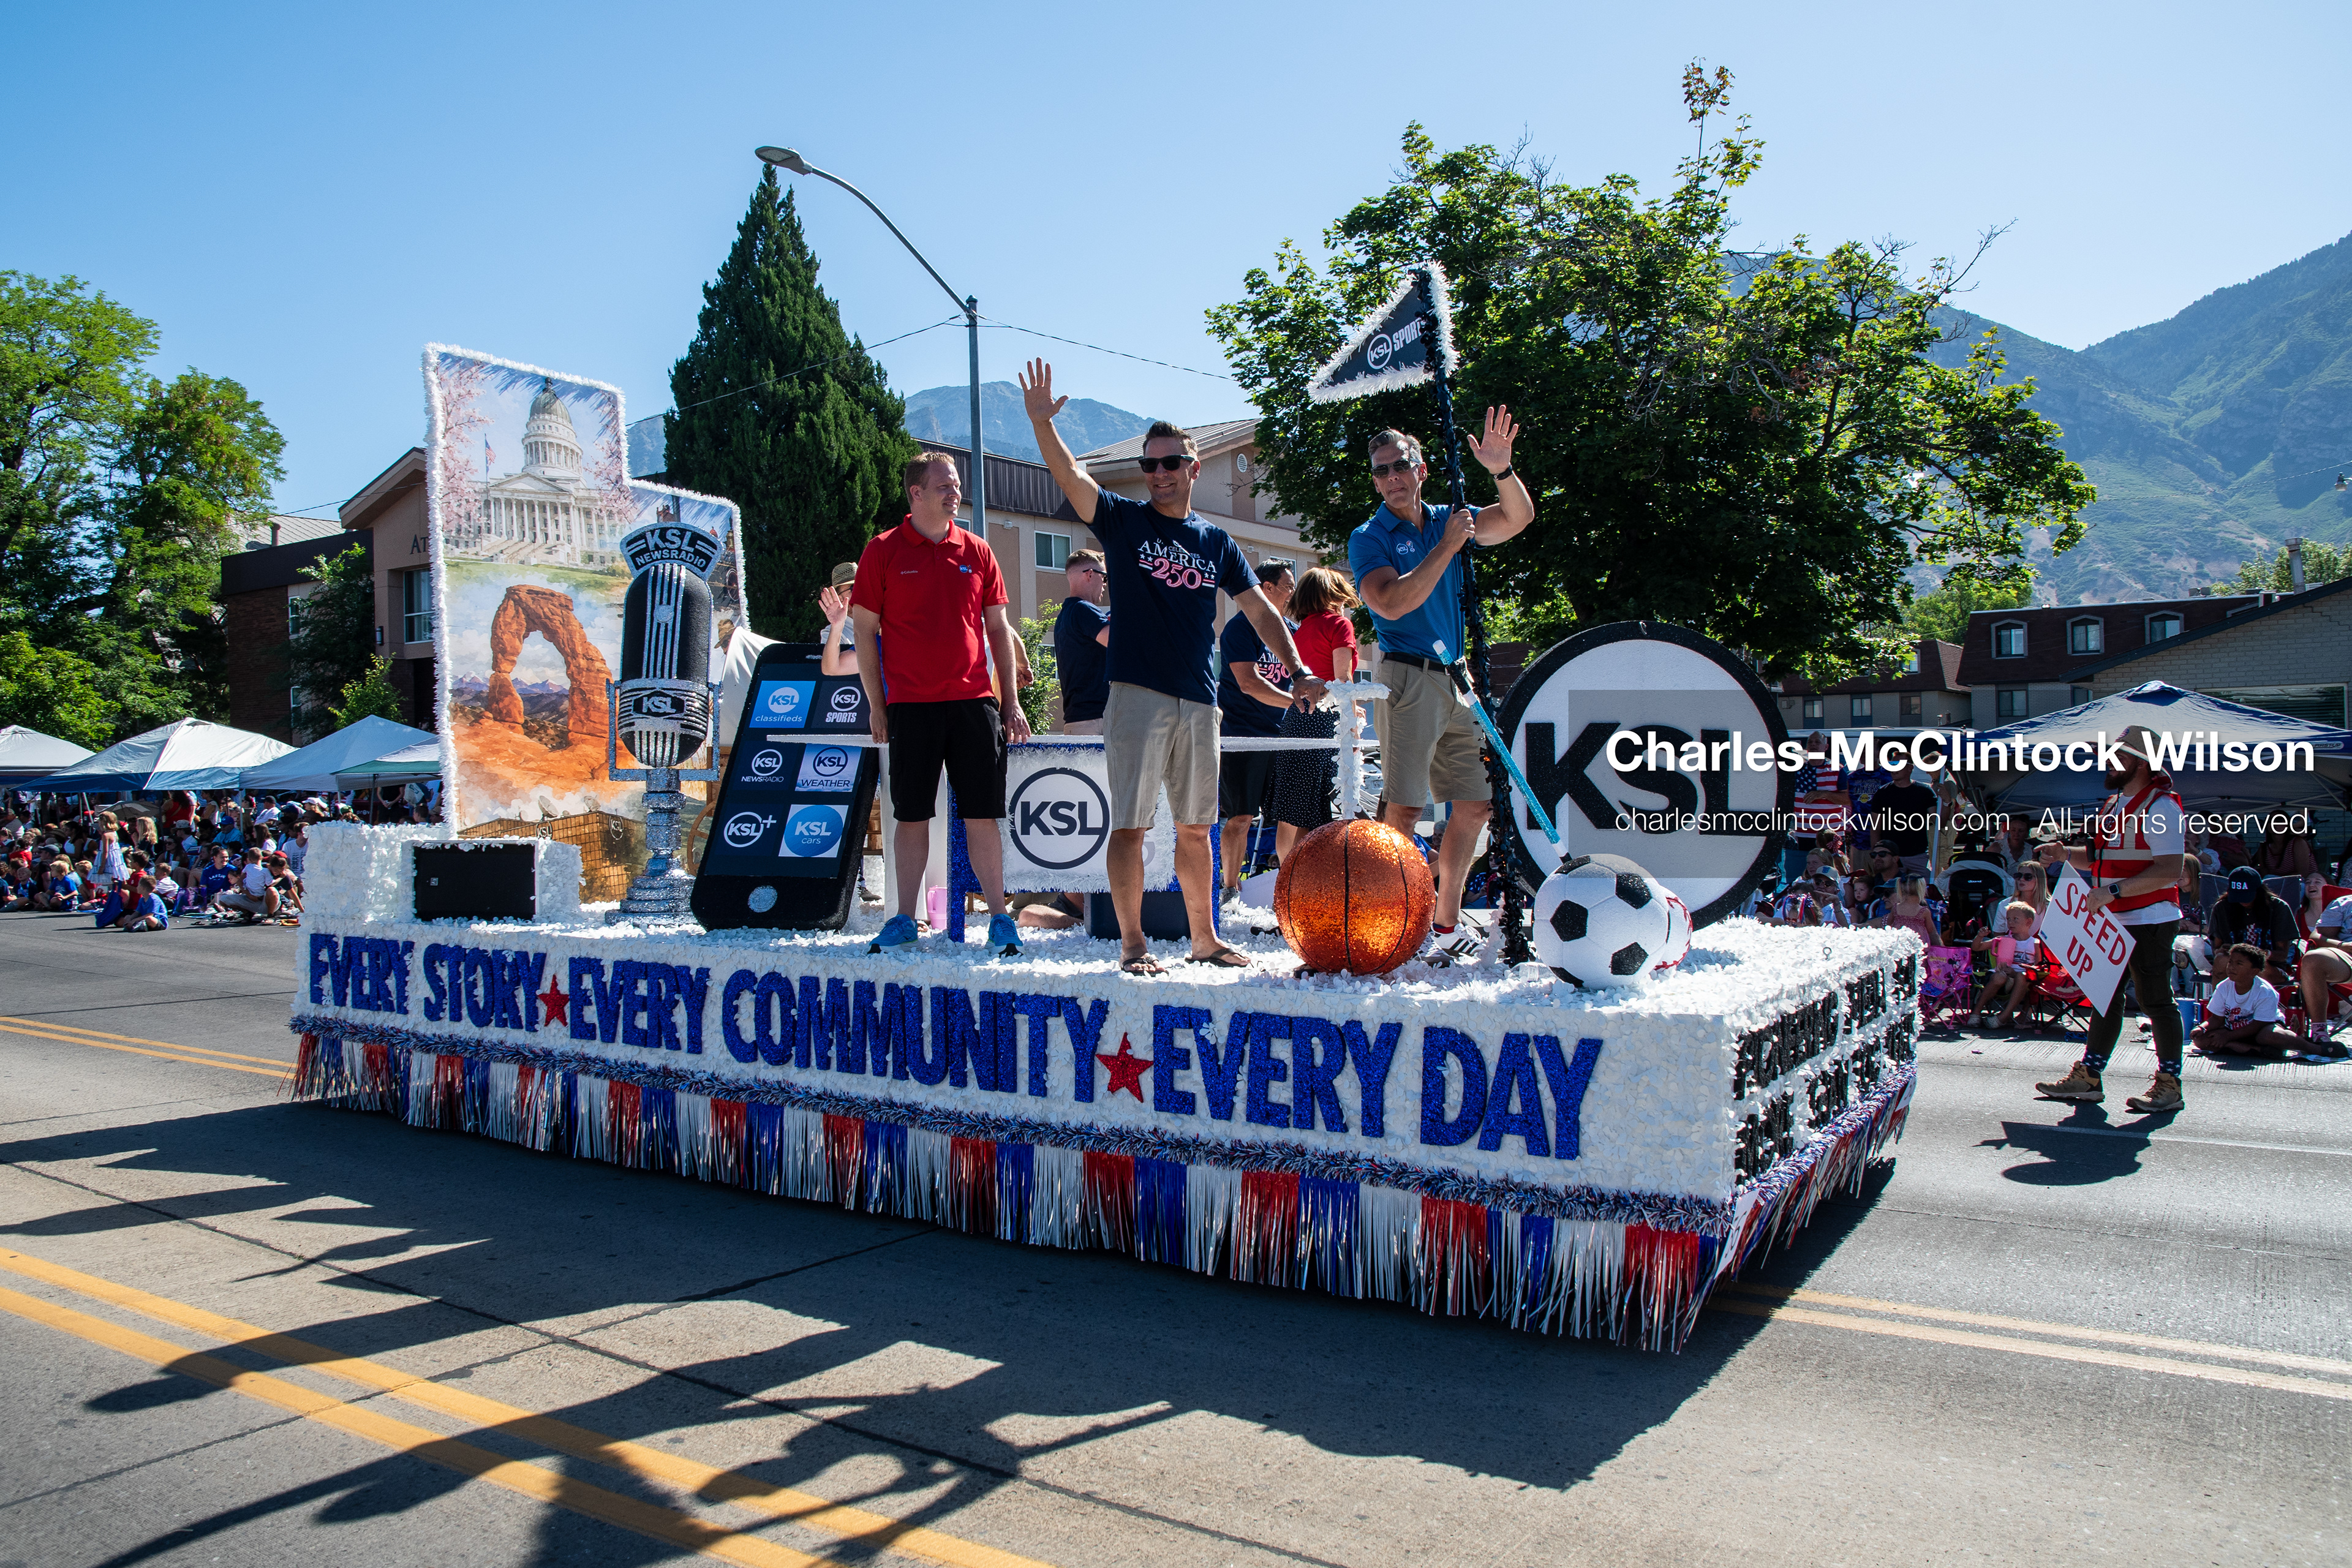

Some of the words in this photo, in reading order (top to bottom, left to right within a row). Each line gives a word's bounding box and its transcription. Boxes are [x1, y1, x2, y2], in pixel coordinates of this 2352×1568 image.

[1370, 342, 1390, 362] KSL
[1392, 317, 1426, 352] SPORT
[646, 529, 695, 552] KSL
[635, 549, 706, 568] NEWSRADIO
[1137, 540, 1217, 573] AMERICA
[1152, 557, 1202, 589] 250
[642, 696, 676, 713] KSL
[770, 695, 799, 706] KSL
[834, 694, 858, 704] KSL
[826, 712, 858, 723] SPORTS
[755, 757, 780, 767] KSL
[816, 756, 845, 767] KSL
[1525, 723, 1773, 837] KSL
[794, 821, 832, 836] KSL
[1020, 801, 1104, 836] KSL
[537, 826, 552, 839] KSL
[2055, 883, 2126, 966] SPEED
[2067, 935, 2093, 979] UP
[310, 933, 415, 1015] EVERY
[423, 943, 547, 1031] STORY
[568, 956, 712, 1054] EVERY
[722, 968, 1110, 1102] COMMUNITY
[1153, 1005, 1403, 1138] EVERY
[1420, 1026, 1604, 1160] DAY
